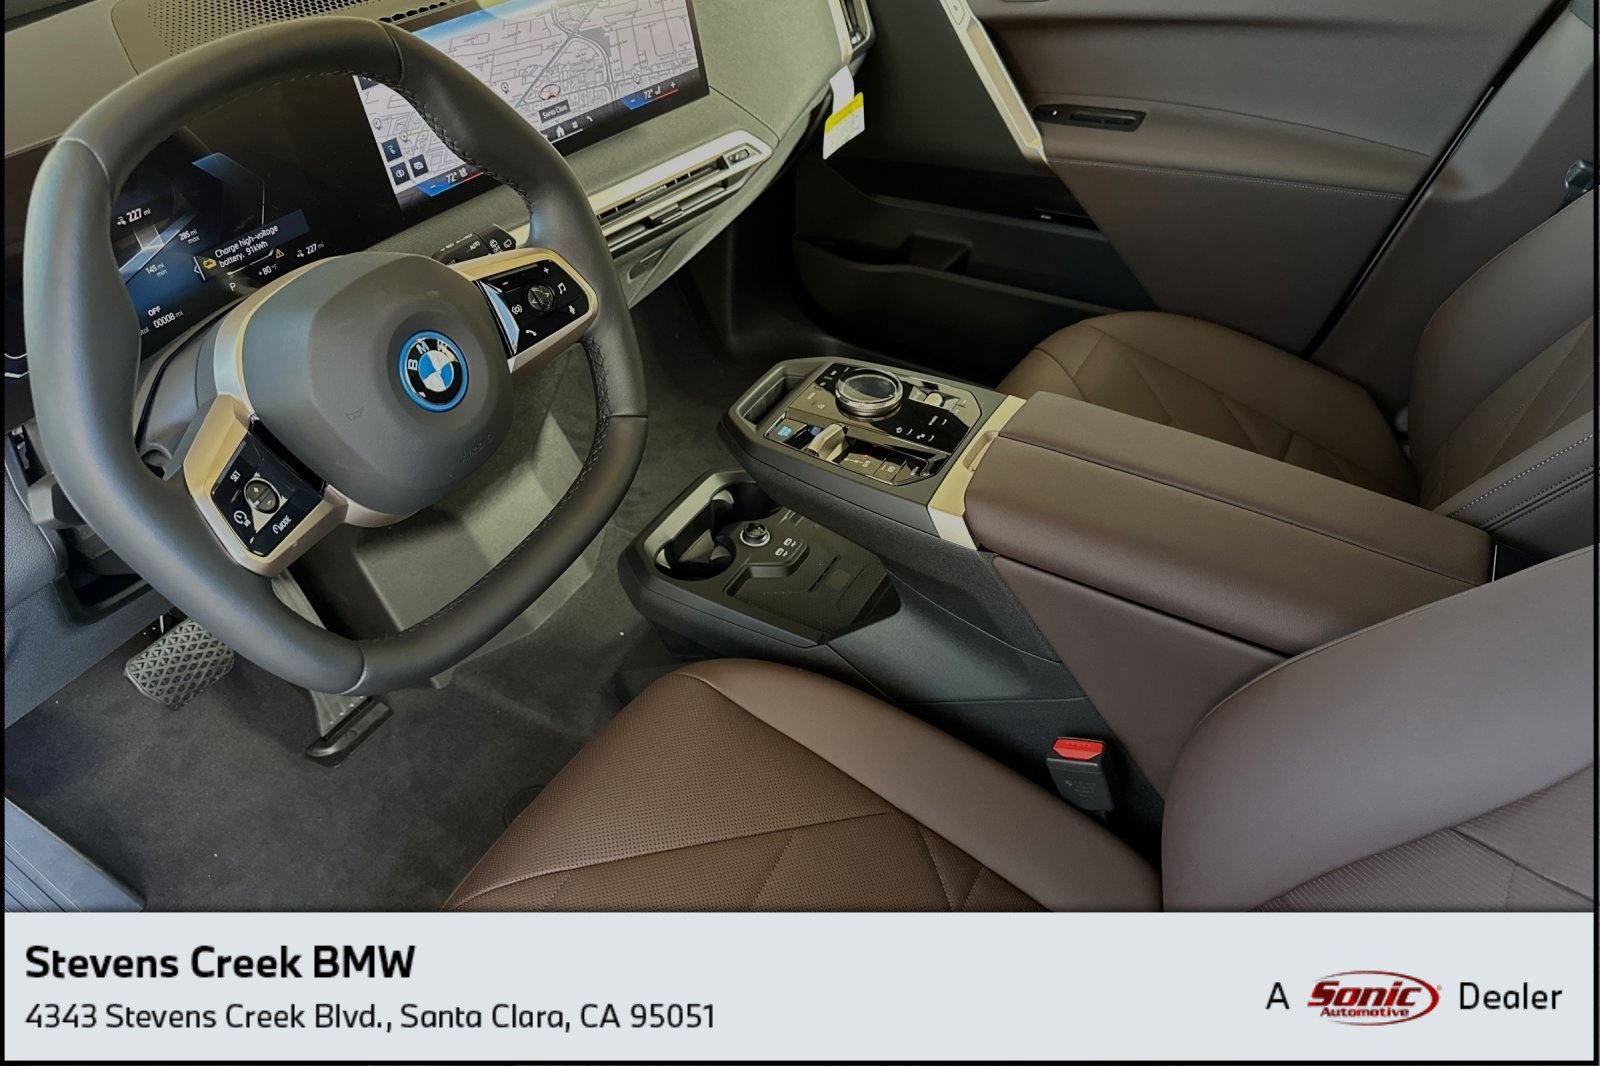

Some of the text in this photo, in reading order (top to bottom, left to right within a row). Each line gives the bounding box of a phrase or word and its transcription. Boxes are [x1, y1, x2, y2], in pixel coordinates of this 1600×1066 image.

[126, 207, 152, 222] 227 mi
[187, 236, 200, 244] max
[214, 225, 279, 258] Charge high-voltage
[218, 240, 269, 268] battery. 91kWh
[305, 243, 317, 255] 227
[145, 264, 157, 275] 145
[229, 282, 236, 291] P
[147, 305, 161, 317] OFF
[153, 312, 176, 328] 00008
[408, 337, 456, 371] BMW
[230, 470, 241, 482] SET
